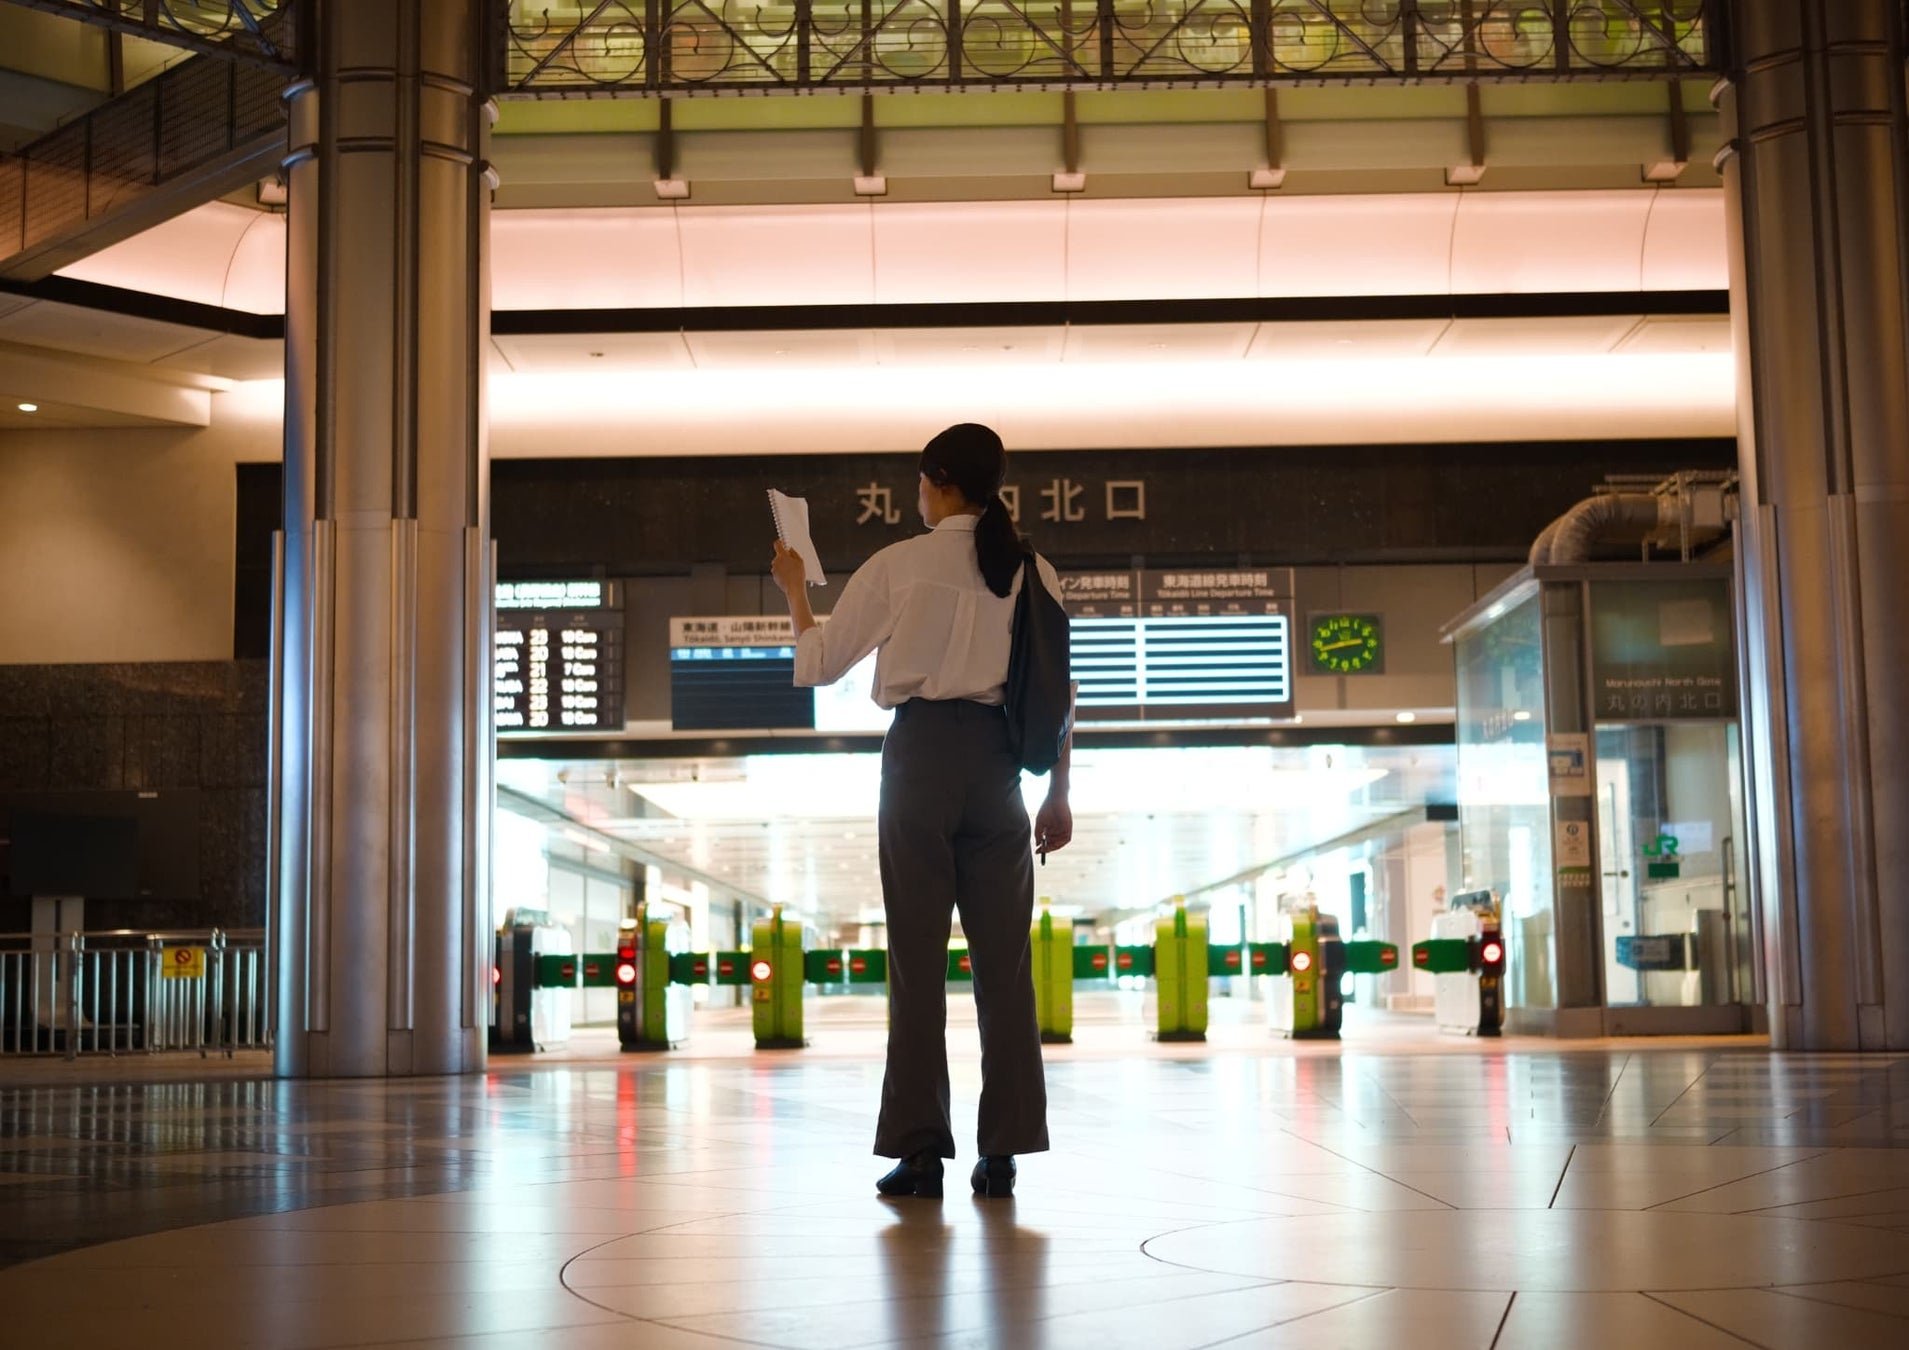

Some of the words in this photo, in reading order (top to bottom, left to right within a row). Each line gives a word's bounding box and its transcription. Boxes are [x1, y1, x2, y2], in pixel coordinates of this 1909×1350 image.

[1192, 589, 1208, 597] Line
[1210, 588, 1252, 598] Departure
[1254, 588, 1274, 597] Time
[1665, 677, 1693, 687] North
[1697, 676, 1722, 687] Gate
[1606, 692, 1722, 712] 丸の内北口
[1642, 834, 1679, 856] JR
